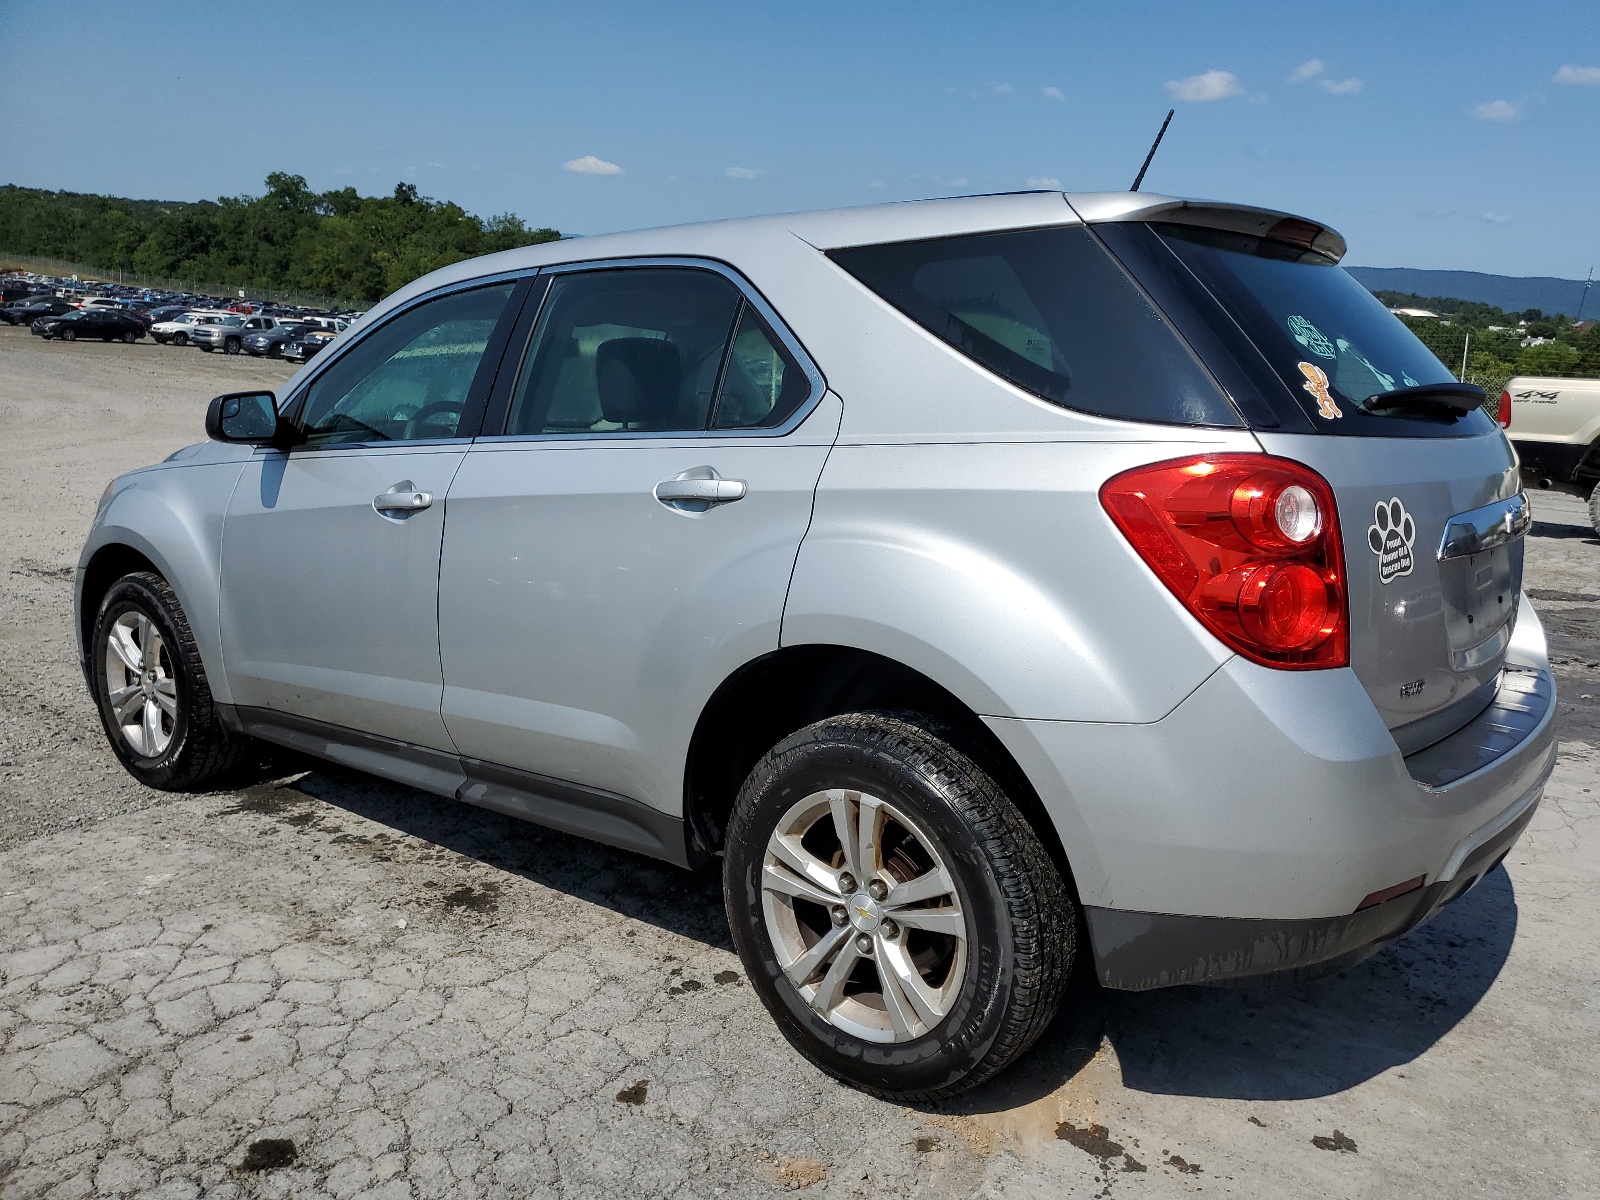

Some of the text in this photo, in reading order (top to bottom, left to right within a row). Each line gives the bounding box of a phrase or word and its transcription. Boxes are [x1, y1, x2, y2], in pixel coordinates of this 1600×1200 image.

[1387, 536, 1401, 550] Proud
[1383, 551, 1398, 563] Owner
[1382, 557, 1410, 576] Rescue Dog
